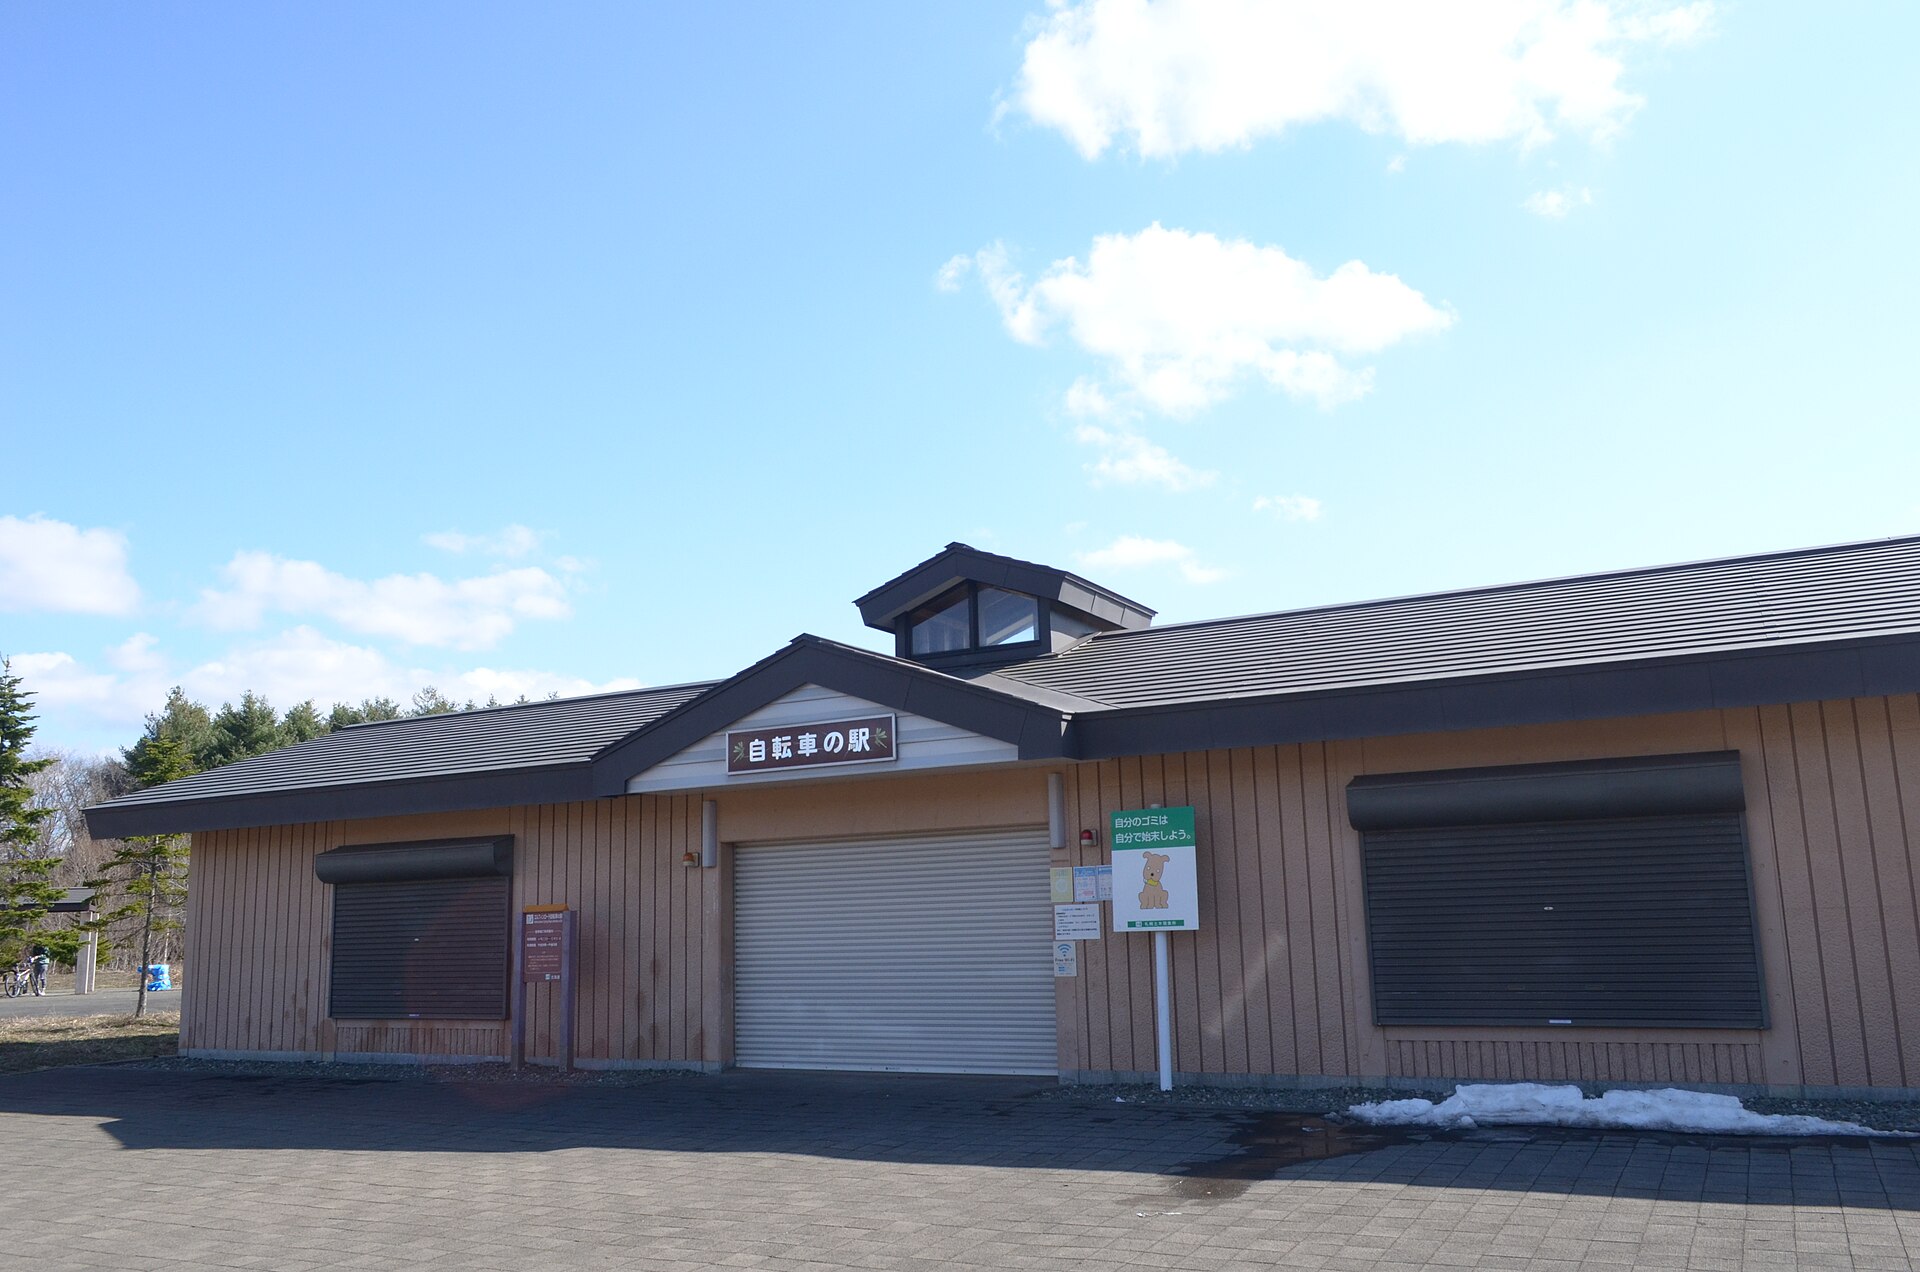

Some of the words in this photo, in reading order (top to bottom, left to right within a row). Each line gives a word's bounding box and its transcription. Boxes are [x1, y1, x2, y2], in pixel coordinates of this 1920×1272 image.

[749, 728, 870, 762] 自転車の駅
[1115, 815, 1168, 828] 自分のゴミは
[1115, 829, 1191, 844] 自分で始末しよう。
